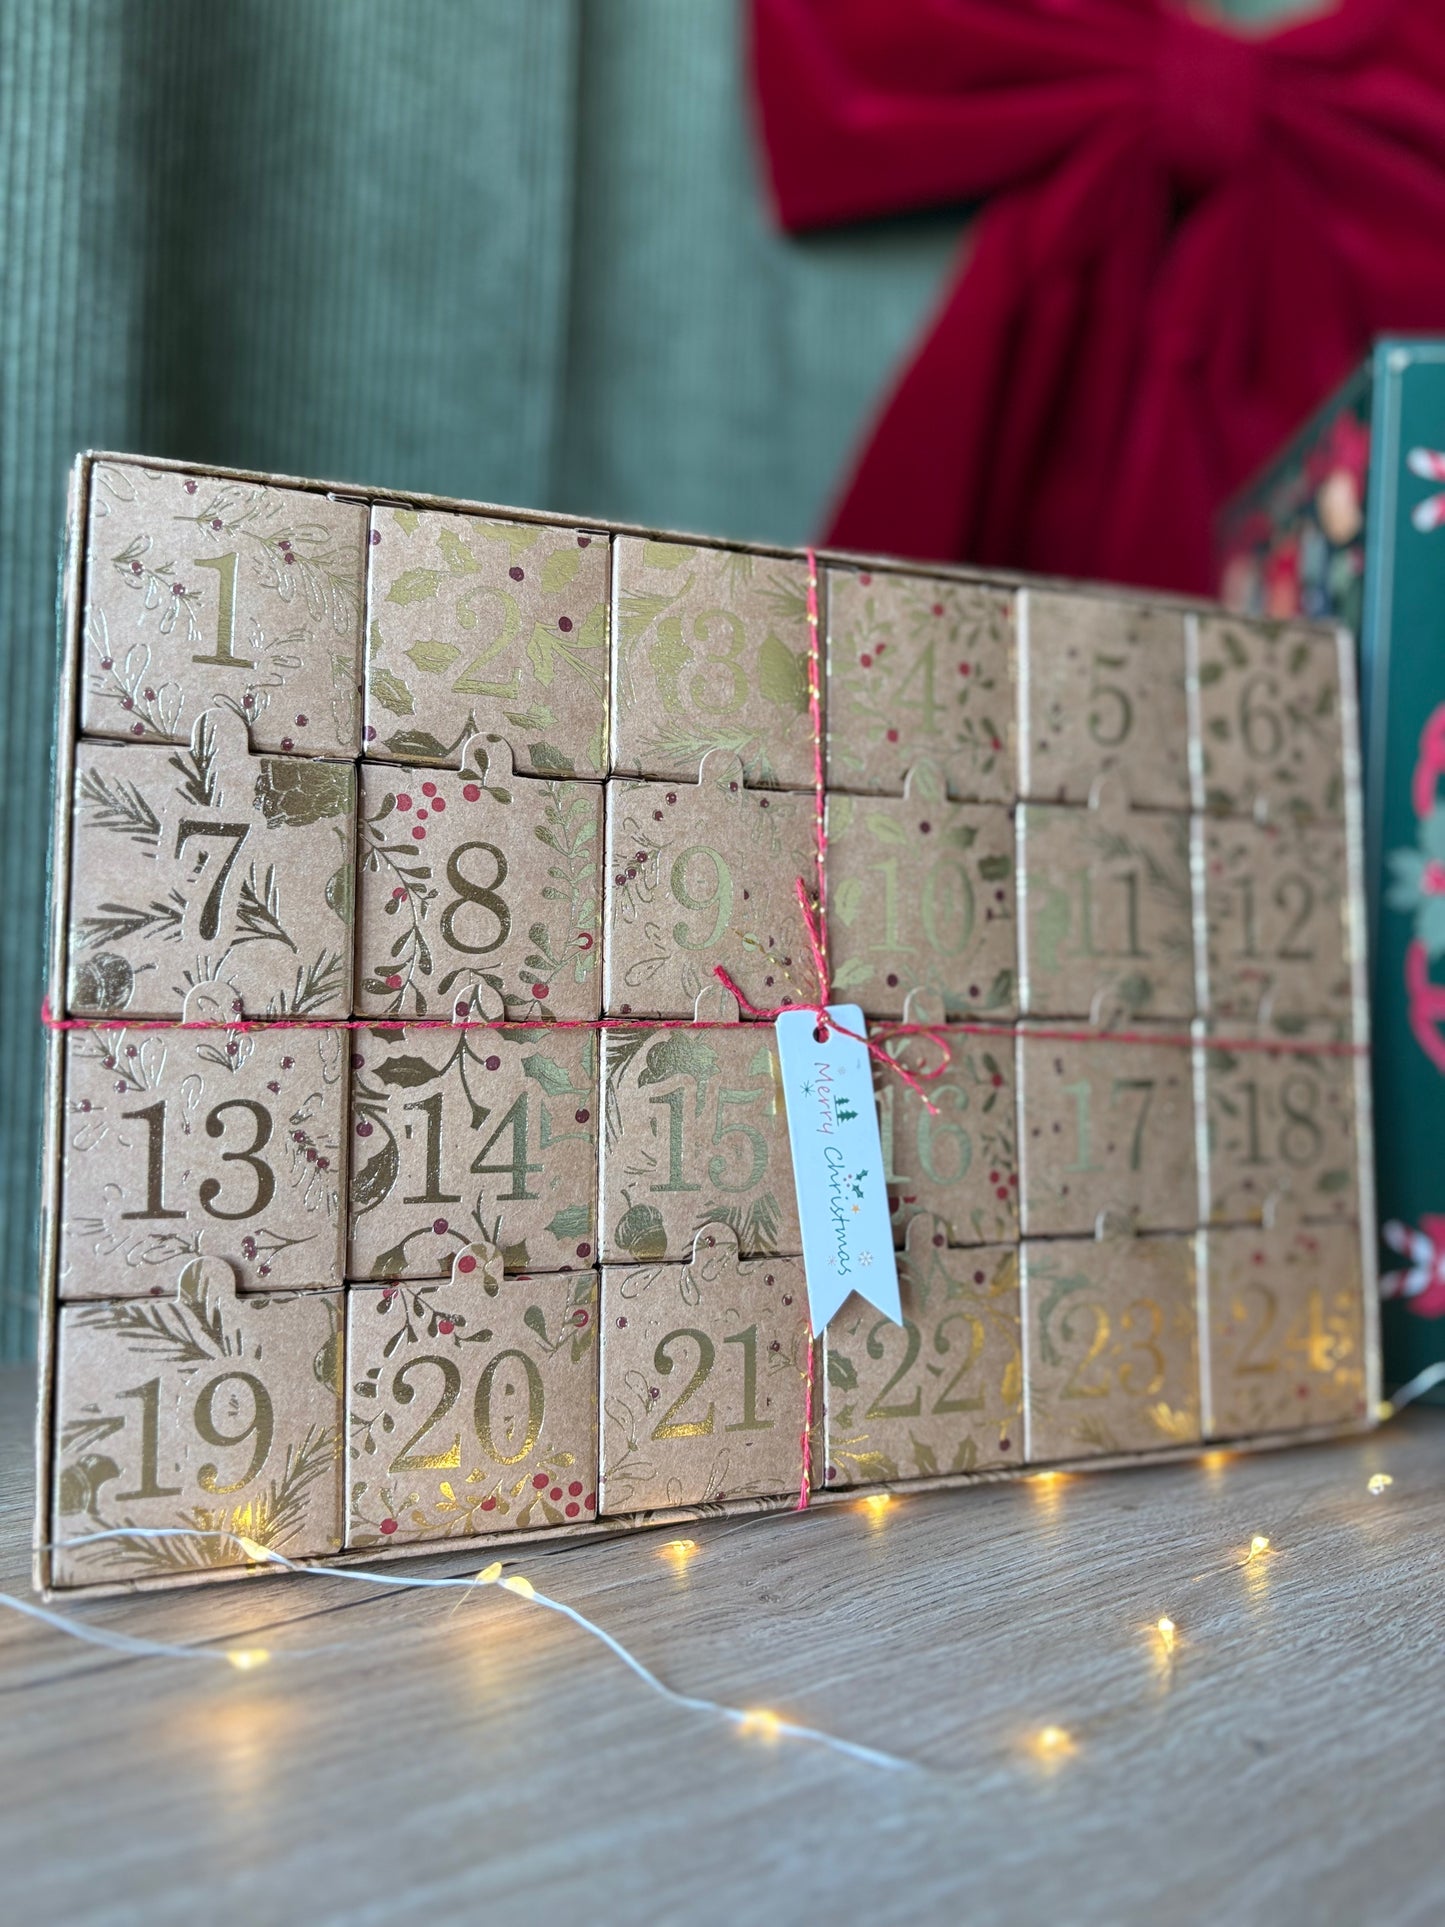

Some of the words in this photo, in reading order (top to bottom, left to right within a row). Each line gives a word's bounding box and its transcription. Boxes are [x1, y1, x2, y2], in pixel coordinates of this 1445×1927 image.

[192, 551, 254, 669] 1
[452, 585, 522, 699] 2
[690, 608, 750, 715] 3
[902, 640, 947, 735] 4
[1087, 653, 1134, 747] 5
[1238, 671, 1283, 762] 6
[174, 818, 252, 940] 7
[440, 841, 512, 954] 8
[671, 845, 733, 950] 9
[868, 857, 976, 957] 10
[1067, 870, 1149, 959] 11
[1230, 873, 1314, 961] 12
[121, 1098, 277, 1220] 13
[403, 1091, 545, 1204] 14
[649, 1086, 769, 1193] 15
[814, 1061, 834, 1135] Merry
[824, 1146, 852, 1276] Christmas
[1062, 1078, 1156, 1171] 17
[1239, 1075, 1323, 1167] 18
[865, 1312, 986, 1420] 22
[1060, 1298, 1166, 1399] 23
[1233, 1282, 1333, 1374] 24
[115, 1370, 275, 1501] 19
[388, 1348, 546, 1474] 20
[651, 1323, 775, 1441] 21
